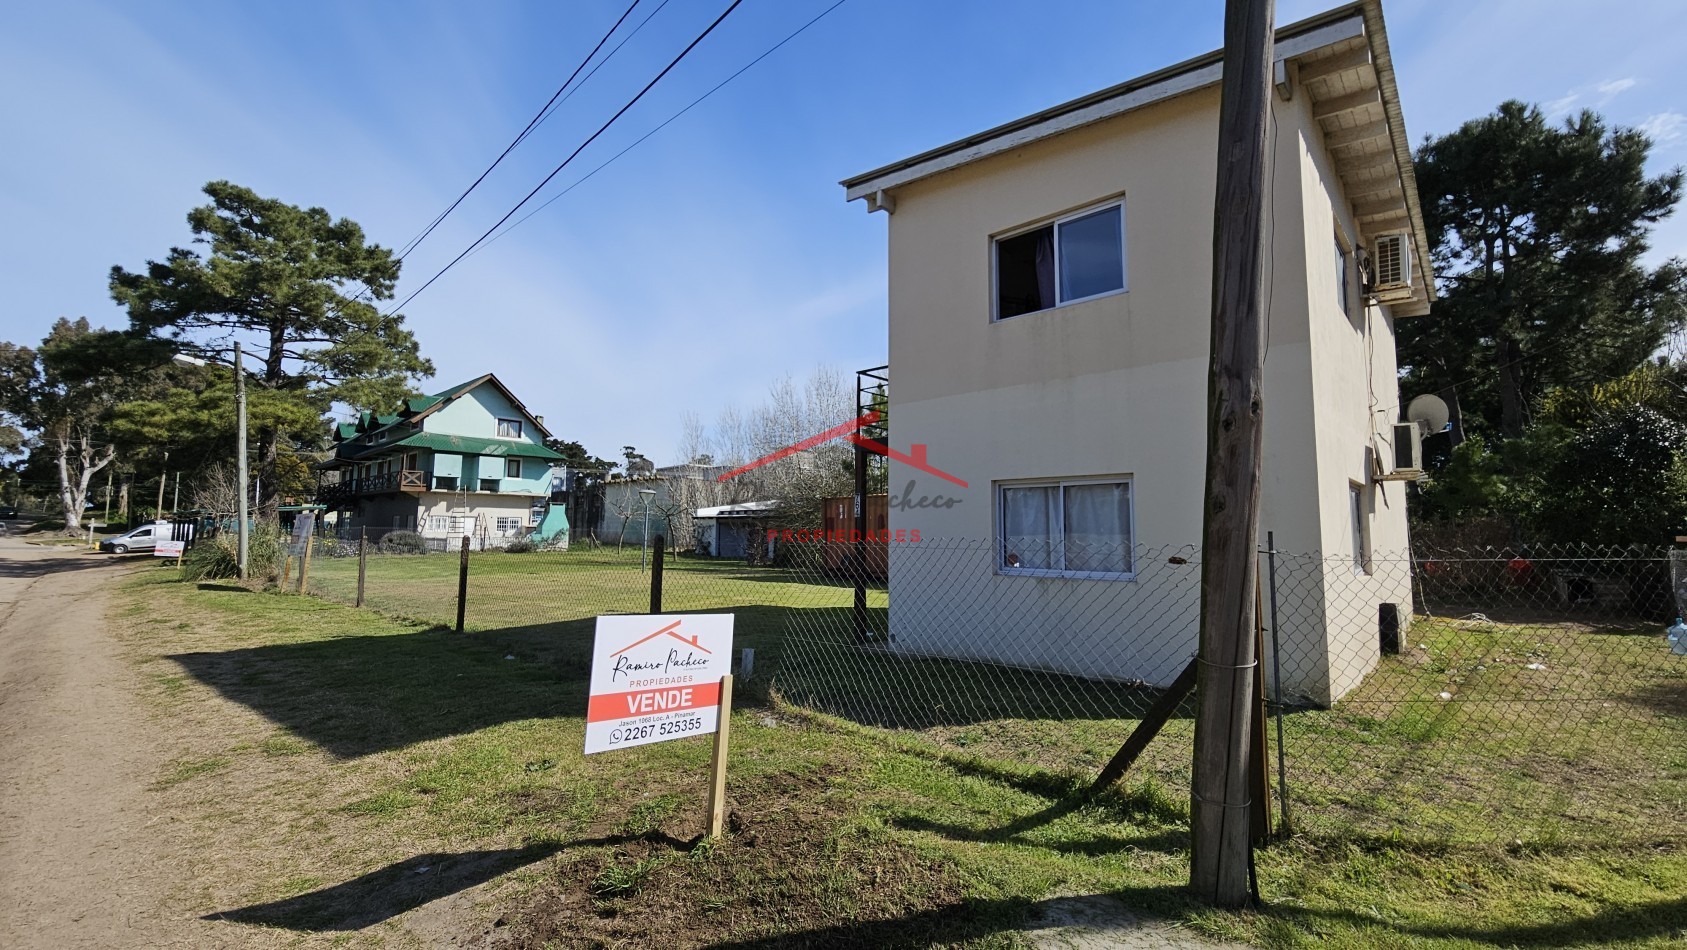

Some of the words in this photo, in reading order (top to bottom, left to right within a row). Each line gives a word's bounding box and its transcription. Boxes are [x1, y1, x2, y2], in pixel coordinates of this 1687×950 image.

[612, 654, 663, 682] Ramiro
[665, 648, 709, 674] Pacheco
[629, 675, 693, 688] PROPIEDADES
[626, 688, 693, 714] VENDE
[623, 724, 656, 741] 2267
[659, 717, 702, 736] 525355
